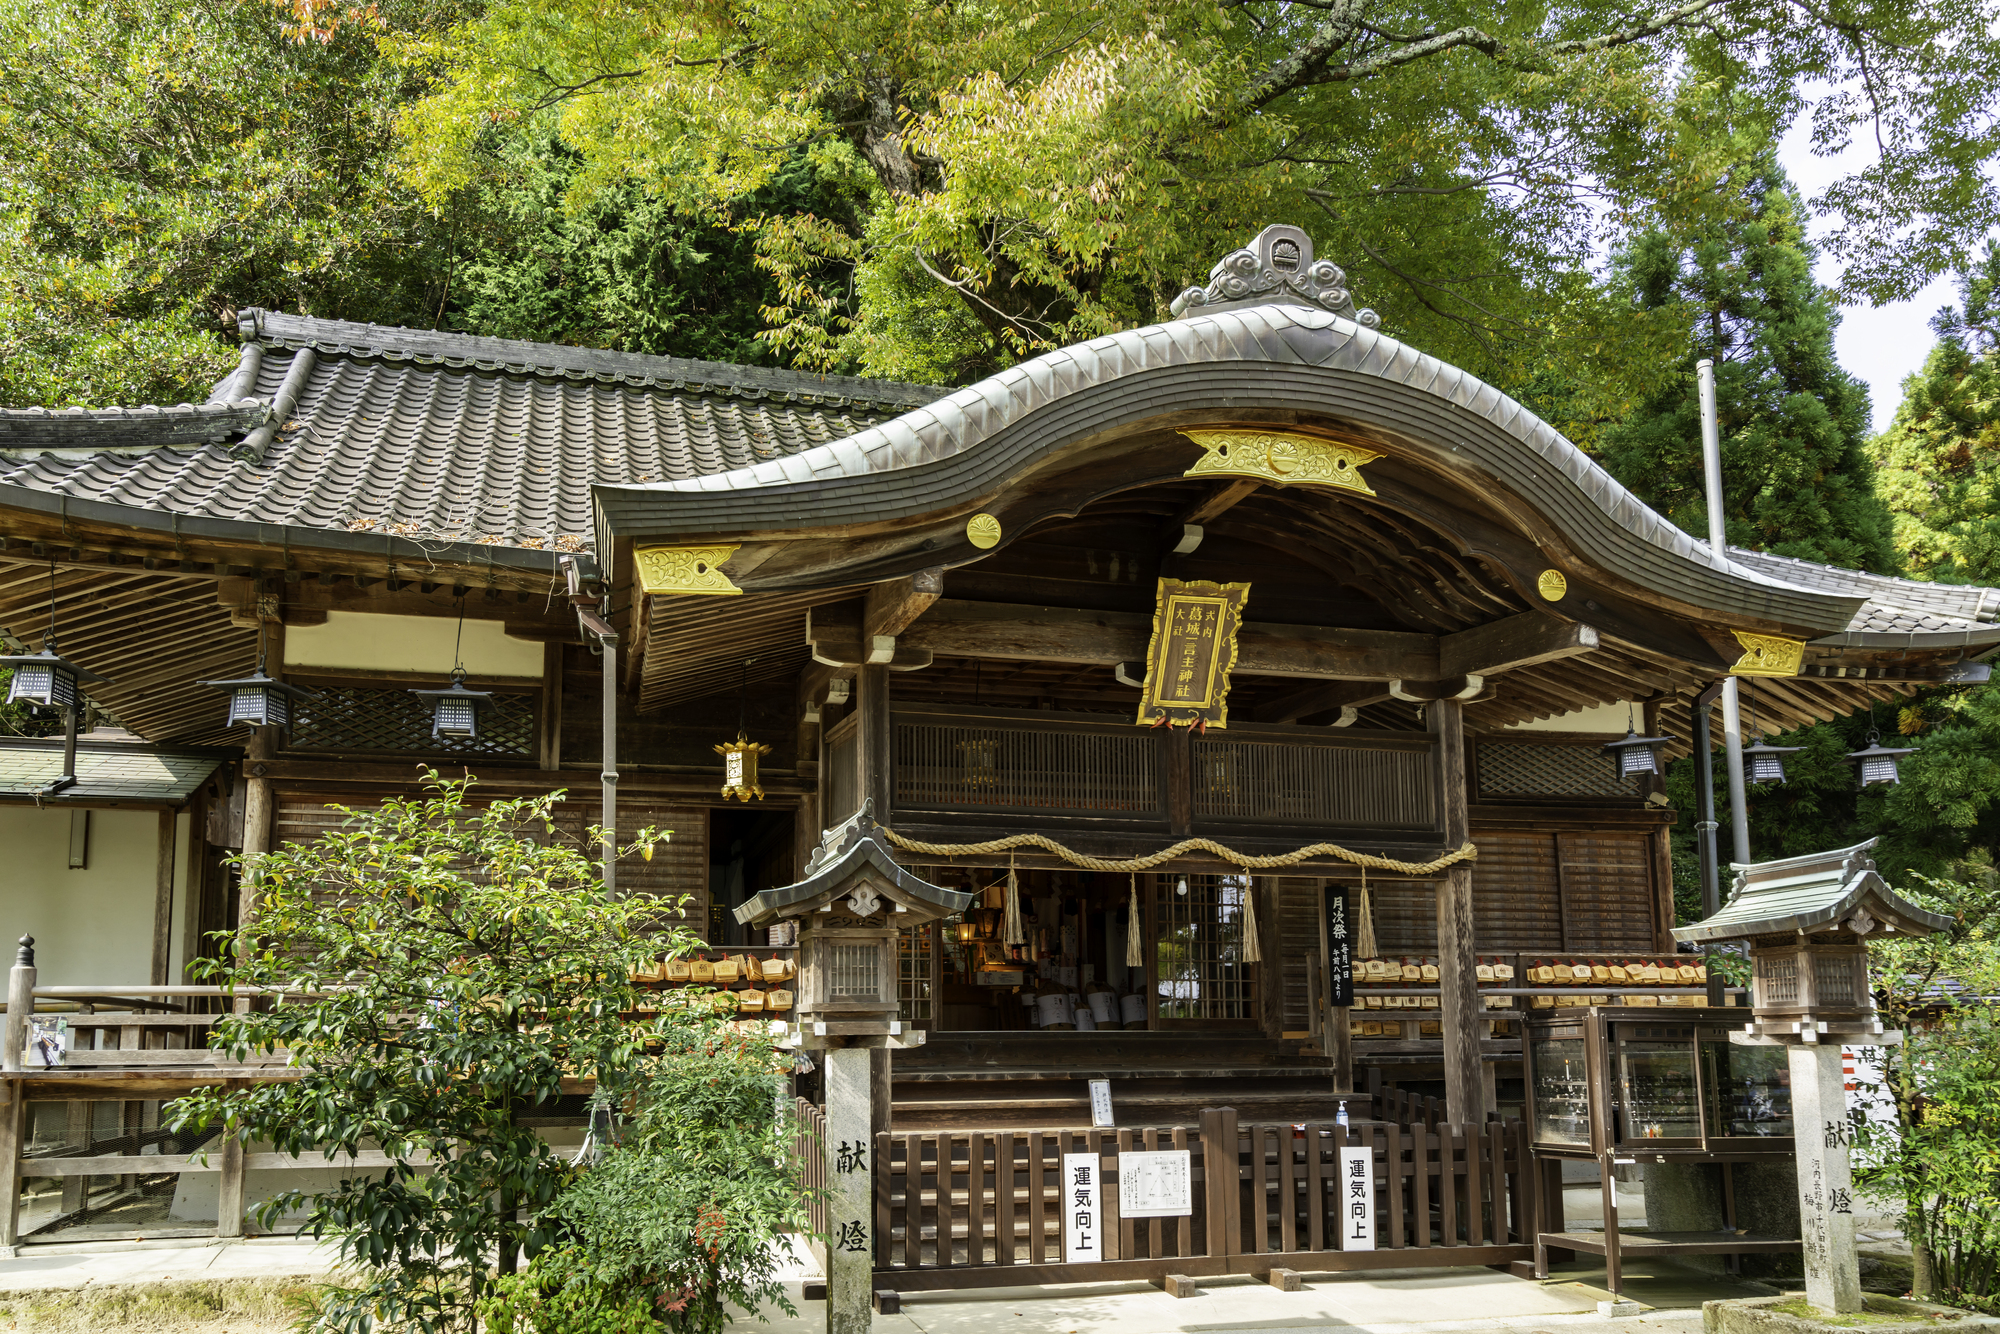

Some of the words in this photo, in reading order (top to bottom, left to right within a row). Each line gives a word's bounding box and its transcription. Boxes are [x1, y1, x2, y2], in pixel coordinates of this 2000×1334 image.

[1172, 608, 1186, 637] 大社
[1175, 606, 1203, 697] 葛城一言主神社
[1202, 610, 1216, 638] 式内
[1332, 896, 1347, 940] 月次祭
[1333, 948, 1342, 999] 午前八時より
[1341, 943, 1350, 979] 毎月一日
[835, 1139, 869, 1252] 献燈
[1349, 1159, 1367, 1239] 運気向上
[1823, 1120, 1853, 1215] 献燈
[1073, 1166, 1093, 1251] 運気向上
